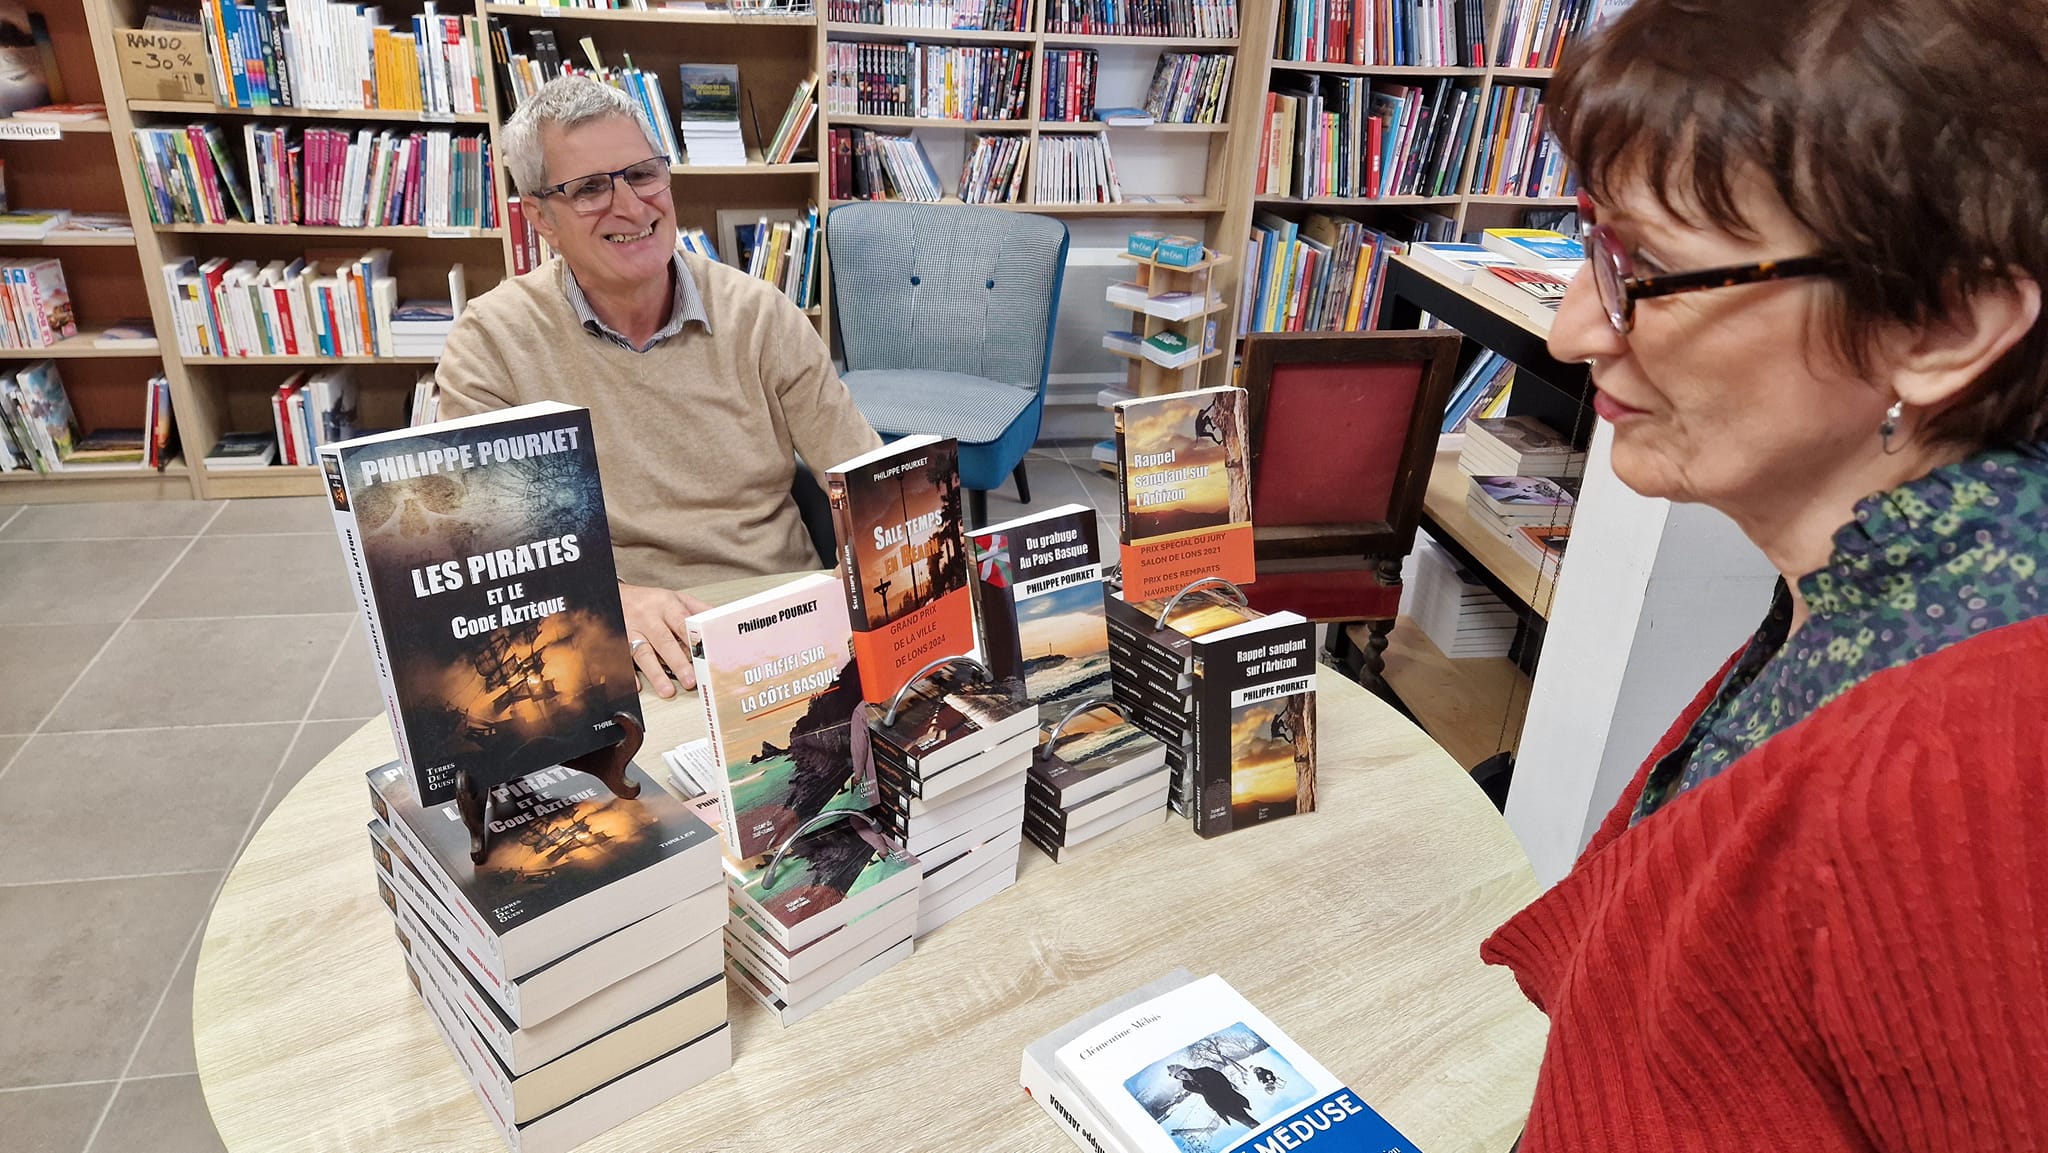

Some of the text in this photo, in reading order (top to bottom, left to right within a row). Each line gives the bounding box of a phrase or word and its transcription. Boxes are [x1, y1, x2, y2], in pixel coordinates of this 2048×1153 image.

[126, 33, 181, 50] RANDO
[361, 444, 474, 485] PHILIPPE
[478, 427, 580, 466] POURXET
[1134, 449, 1176, 468] Rappel
[873, 457, 928, 482] PHILIPPE POURXET
[1135, 465, 1209, 489] sanglant sur
[1136, 487, 1186, 507] l'Arbizon
[873, 509, 943, 550] SALE TEMPS
[1026, 527, 1078, 551] Du grabuge
[1019, 542, 1088, 570] Au Pays Basque
[1140, 544, 1159, 555] PRIX
[1194, 536, 1205, 545] DU
[1207, 533, 1226, 545] JURY
[411, 534, 580, 598] LES PIRATES
[884, 556, 898, 577] EN
[1140, 555, 1167, 567] SALON
[1168, 553, 1179, 562] DE
[1181, 549, 1202, 561] LONS
[1026, 568, 1095, 596] PHILIPPE POURXET
[1143, 564, 1221, 585] PRIX DES REMPARTS
[487, 582, 524, 605] ET LE
[452, 596, 566, 640] CODE AZTÈQUE
[738, 600, 818, 634] Philippe POURXET
[890, 604, 937, 636] GRAND PRIX
[894, 621, 937, 651] DE LA VILLE
[896, 634, 946, 669] DE LONS 2024
[1237, 638, 1306, 664] Rappel sanglant
[744, 646, 825, 686] DU RIFIFI SUR
[1246, 657, 1297, 677] sur l'Arbizon
[741, 667, 840, 714] LA CÔTE BASQUE
[1243, 680, 1309, 702] PHILIPPE POURXET
[593, 720, 616, 731] THRIL
[426, 763, 455, 776] TERRES
[429, 779, 456, 791] OUEST
[517, 791, 552, 810] ET LE
[489, 811, 535, 833] CODE
[659, 830, 695, 849] THRILLER
[1079, 1012, 1163, 1062] Clémentine Mélois
[1050, 1093, 1080, 1132] JAENADA
[1253, 1093, 1364, 1153] MÉDUSE
